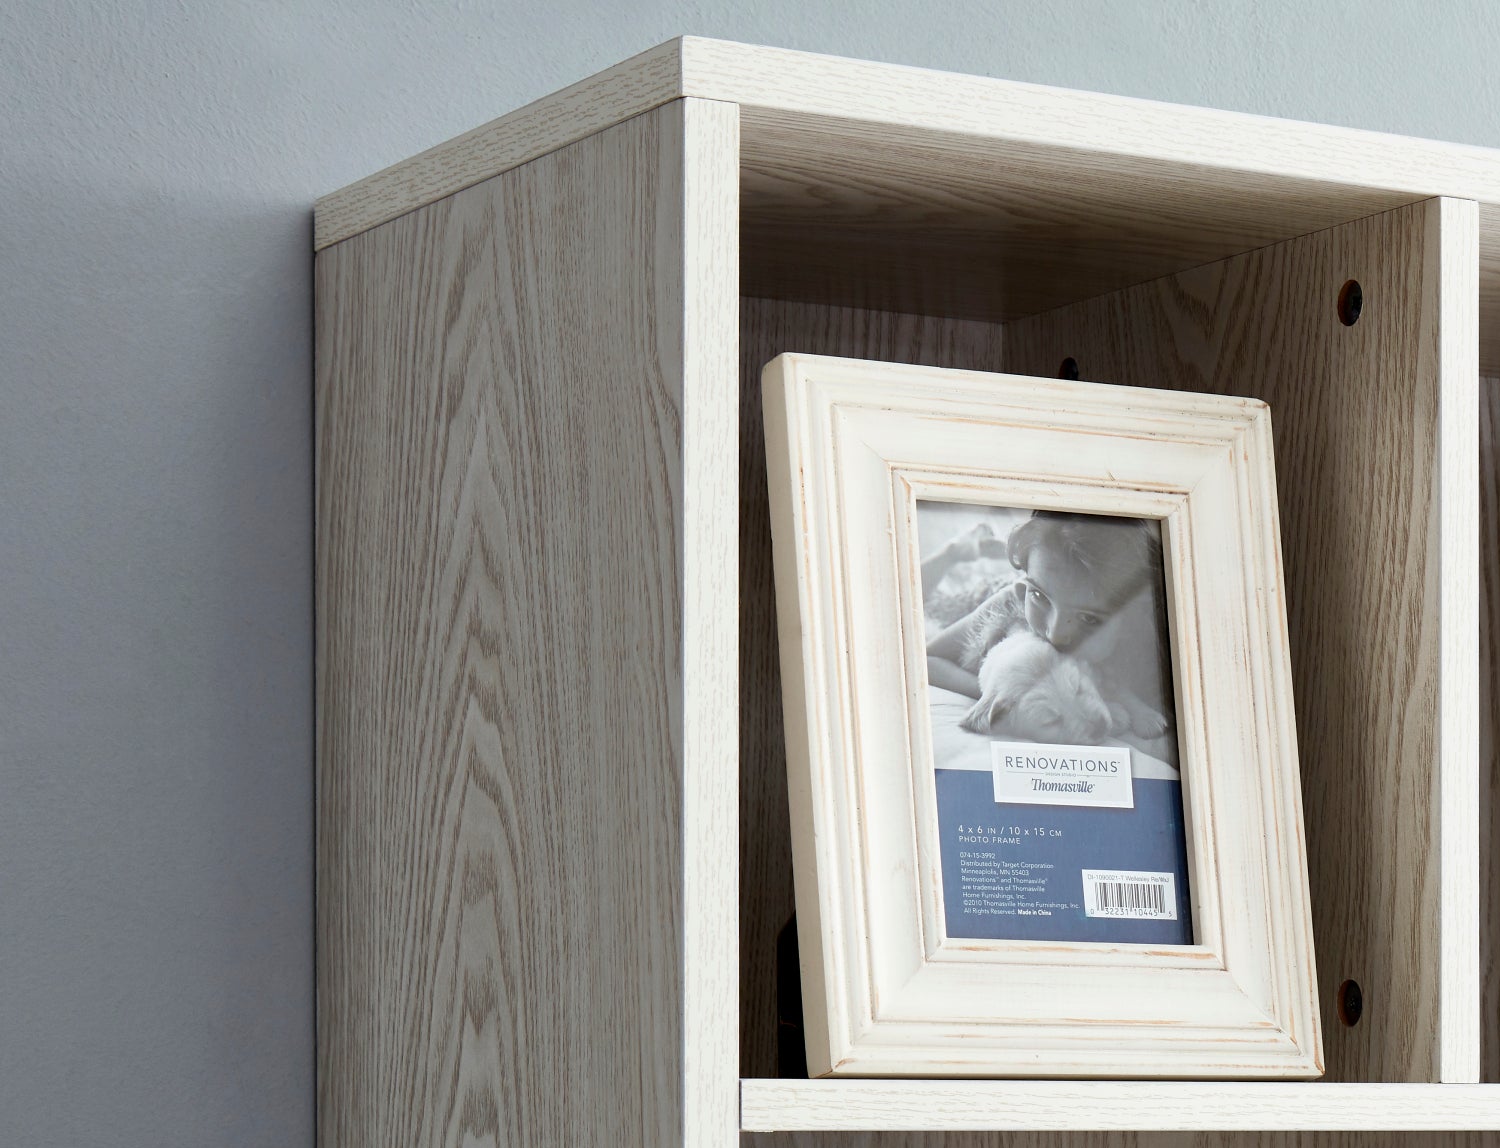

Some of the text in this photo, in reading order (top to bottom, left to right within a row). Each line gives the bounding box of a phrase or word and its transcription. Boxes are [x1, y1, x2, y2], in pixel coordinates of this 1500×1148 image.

[958, 825, 963, 833] 4
[977, 825, 983, 834] 6
[1009, 827, 1020, 835] 10
[1034, 828, 1045, 836] 15
[1002, 860, 1020, 868] Target
